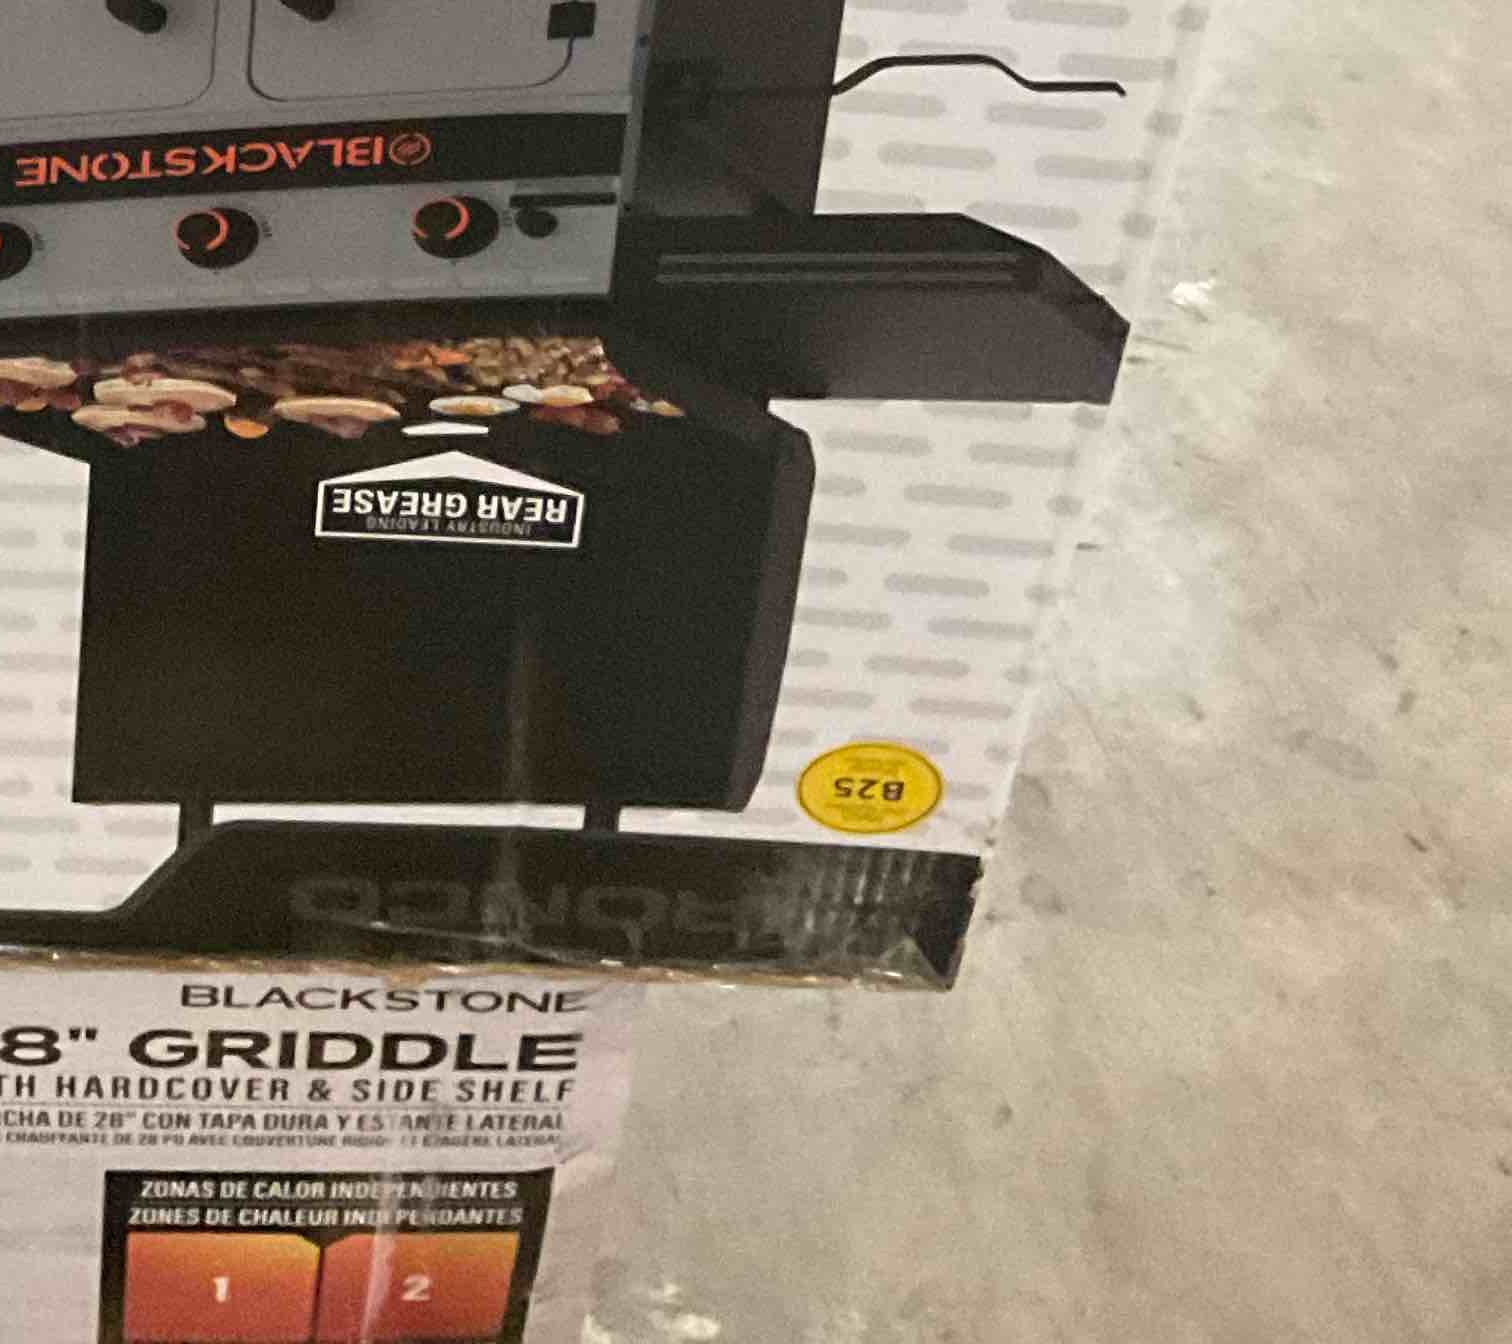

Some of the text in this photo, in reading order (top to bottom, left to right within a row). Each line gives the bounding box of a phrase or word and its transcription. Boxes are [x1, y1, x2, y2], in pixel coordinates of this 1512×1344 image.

[14, 133, 385, 188] BLACKSTONE
[332, 488, 567, 523] REAR GREASE
[833, 777, 904, 801] B25
[180, 985, 587, 1014] BLACKSTONE
[128, 1029, 584, 1073] GRIDDLE
[56, 1075, 290, 1103] HARDCOVER
[307, 1078, 332, 1103] &
[353, 1078, 442, 1103] SIDE
[457, 1078, 575, 1104] SHELF
[58, 1110, 87, 1128] DE
[142, 1112, 189, 1130] CON
[198, 1113, 256, 1130] TAPA
[263, 1113, 328, 1130] DURA
[338, 1114, 349, 1130] Y
[141, 1181, 214, 1198] ZONAS
[220, 1181, 248, 1198] DE
[253, 1182, 326, 1199] CALOR
[128, 1208, 199, 1225] ZONES
[205, 1208, 232, 1225] DE
[239, 1208, 338, 1226] CHALEUR
[213, 1275, 229, 1304] 1
[402, 1275, 432, 1304] 2
